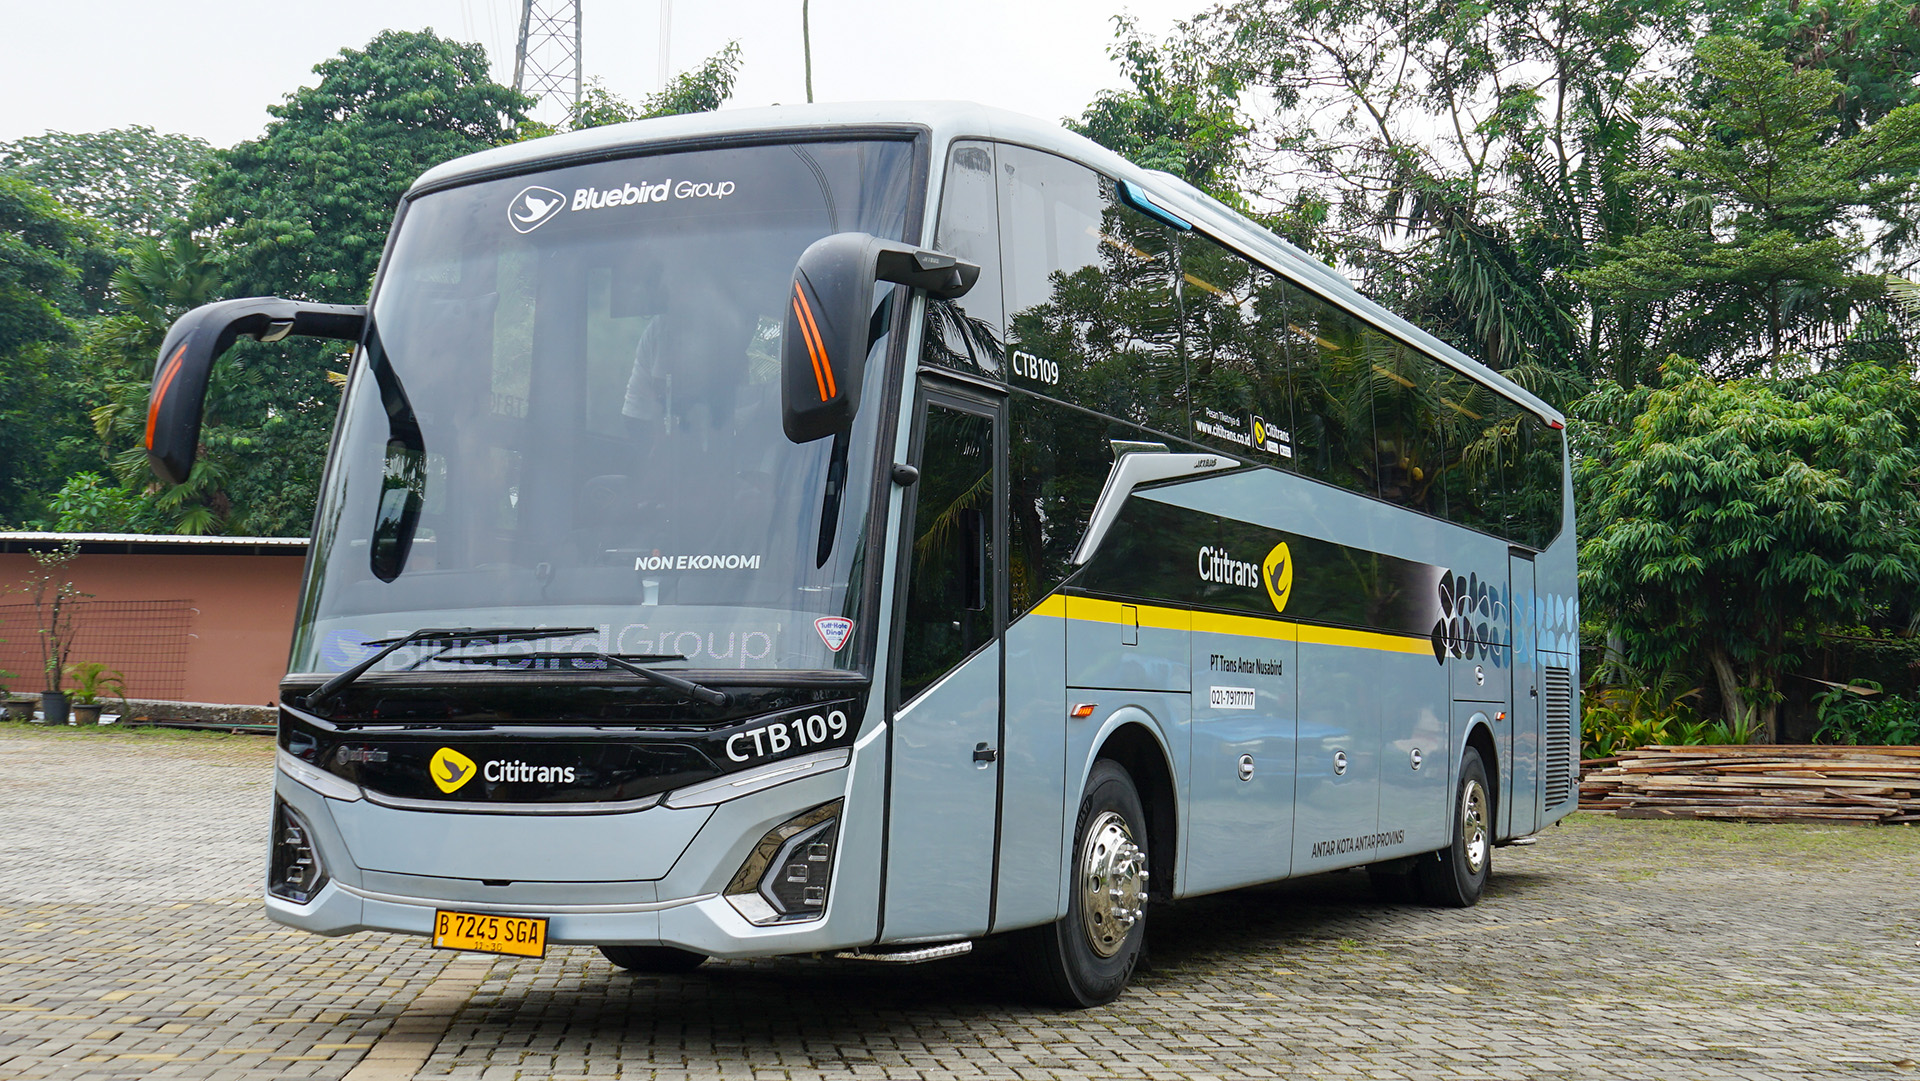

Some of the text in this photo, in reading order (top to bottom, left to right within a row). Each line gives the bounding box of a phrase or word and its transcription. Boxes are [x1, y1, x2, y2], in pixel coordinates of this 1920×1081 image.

[571, 178, 735, 211] Bluebird Group
[1012, 350, 1059, 385] CTB109
[1195, 420, 1251, 447] www.cititrans.co.id
[1265, 422, 1290, 443] Cititrans
[635, 555, 761, 571] NON EKONOMI
[1198, 545, 1259, 589] Cititrans
[617, 623, 772, 669] Group
[1210, 654, 1282, 676] PT Trans Antar Nusabird
[1211, 690, 1254, 706] 021-79171717
[484, 760, 575, 783] Cititrans
[1311, 830, 1405, 858] ANTAR KOTA ANTAR PROVINSI
[440, 914, 538, 944] B 7245 SGA
